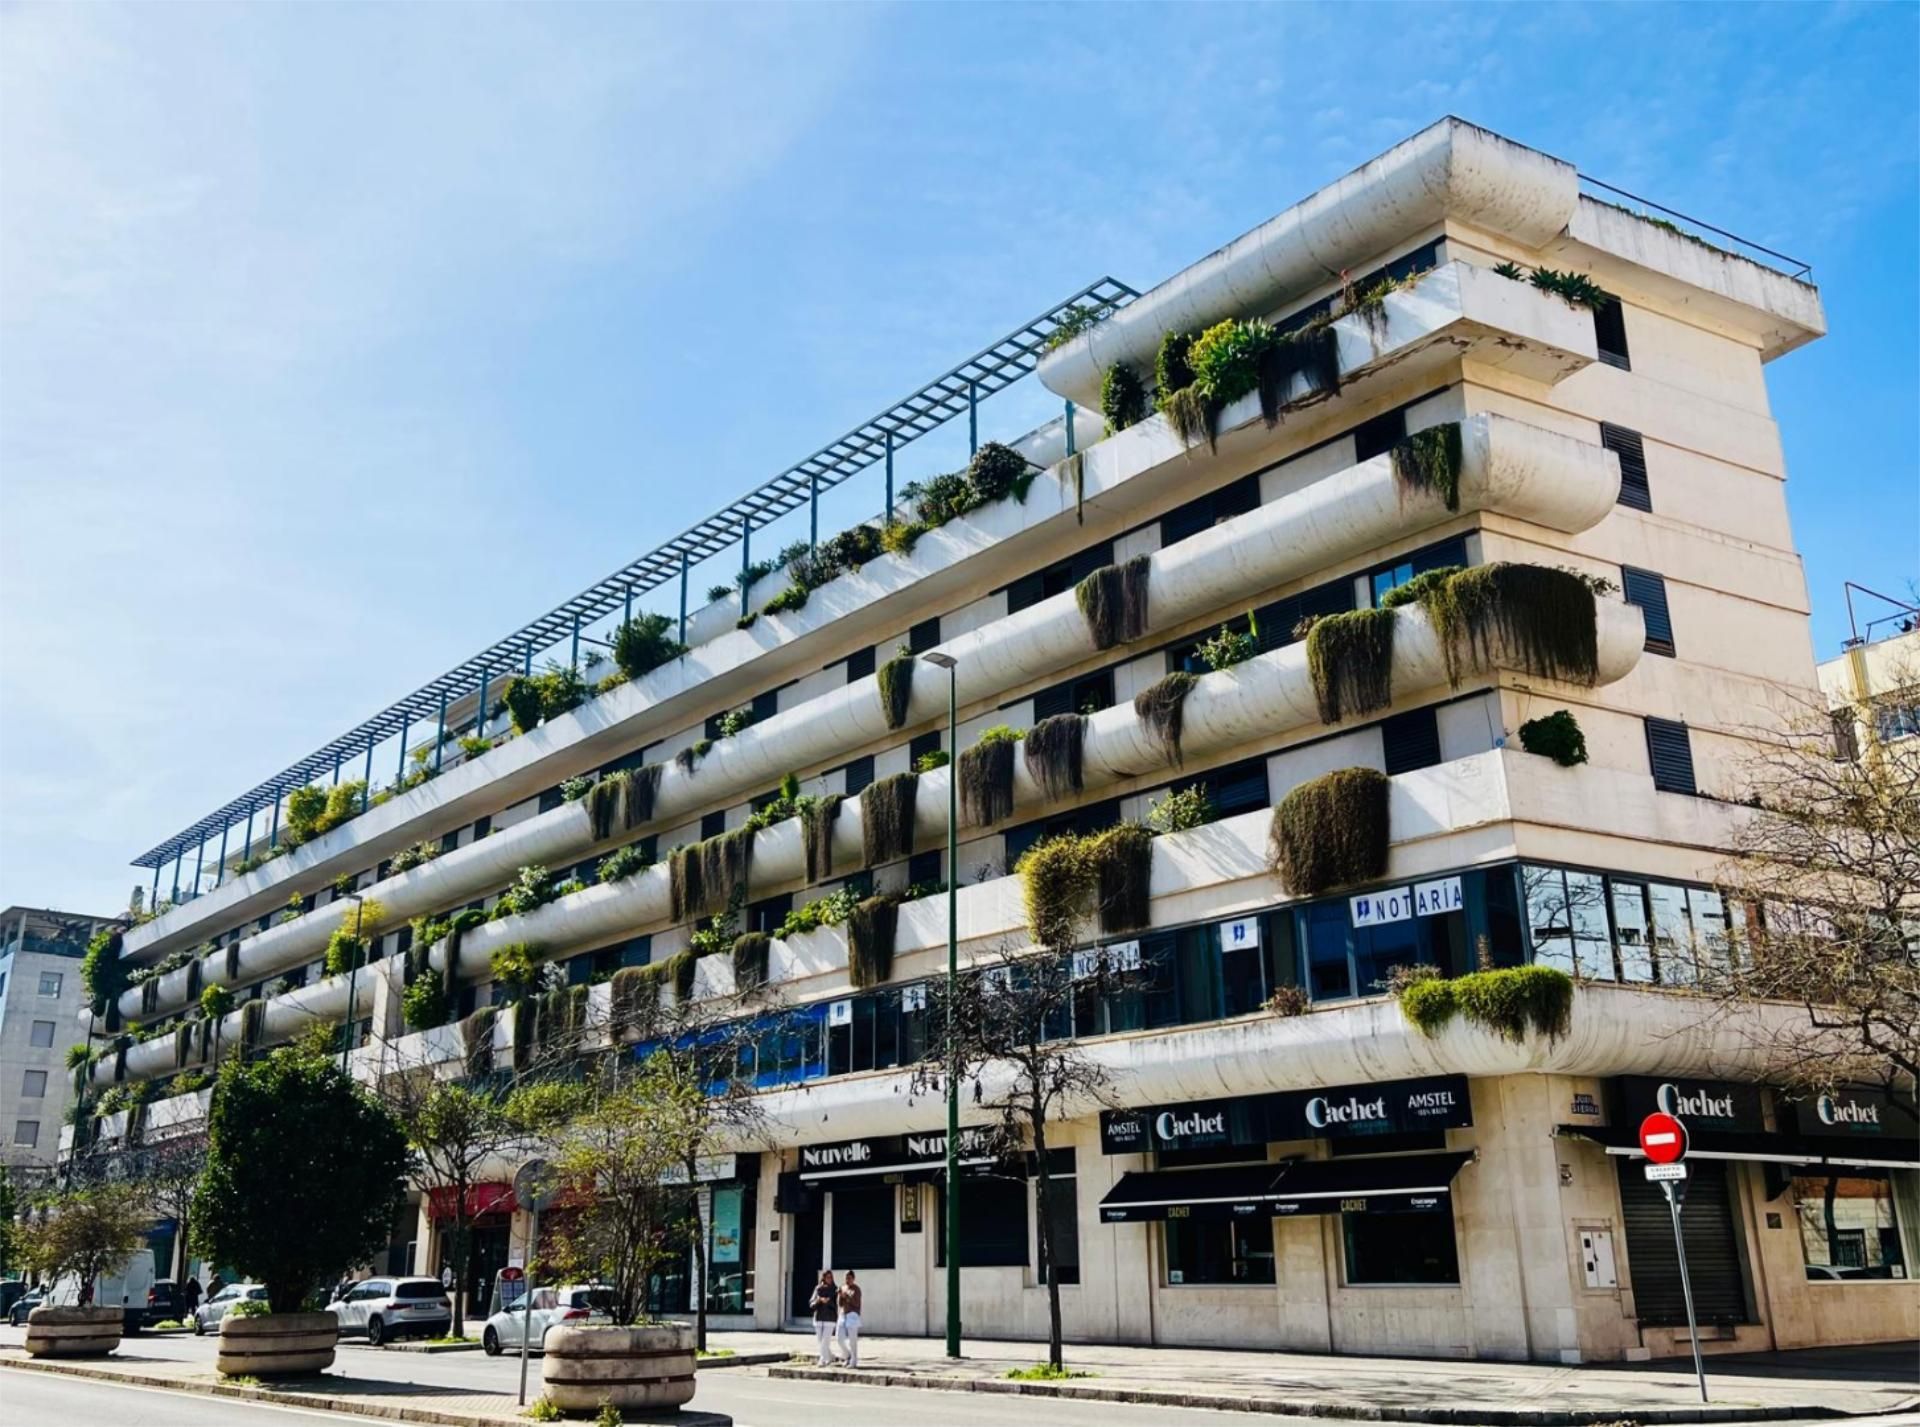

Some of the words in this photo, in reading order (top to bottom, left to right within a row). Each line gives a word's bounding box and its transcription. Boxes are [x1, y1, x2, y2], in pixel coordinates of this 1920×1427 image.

[1376, 881, 1463, 920] NOTARÍA
[1305, 1096, 1388, 1128] Cachet
[1408, 1091, 1456, 1109] AMSTEL
[1657, 1082, 1736, 1118] Cachet
[1817, 1094, 1879, 1126] Cachet
[1108, 1121, 1141, 1136] AMSTEL
[1156, 1111, 1225, 1141] Cachet
[803, 1142, 871, 1167] Nouvelle
[1167, 1206, 1190, 1218] CACHET
[1340, 1199, 1367, 1212] CACHET
